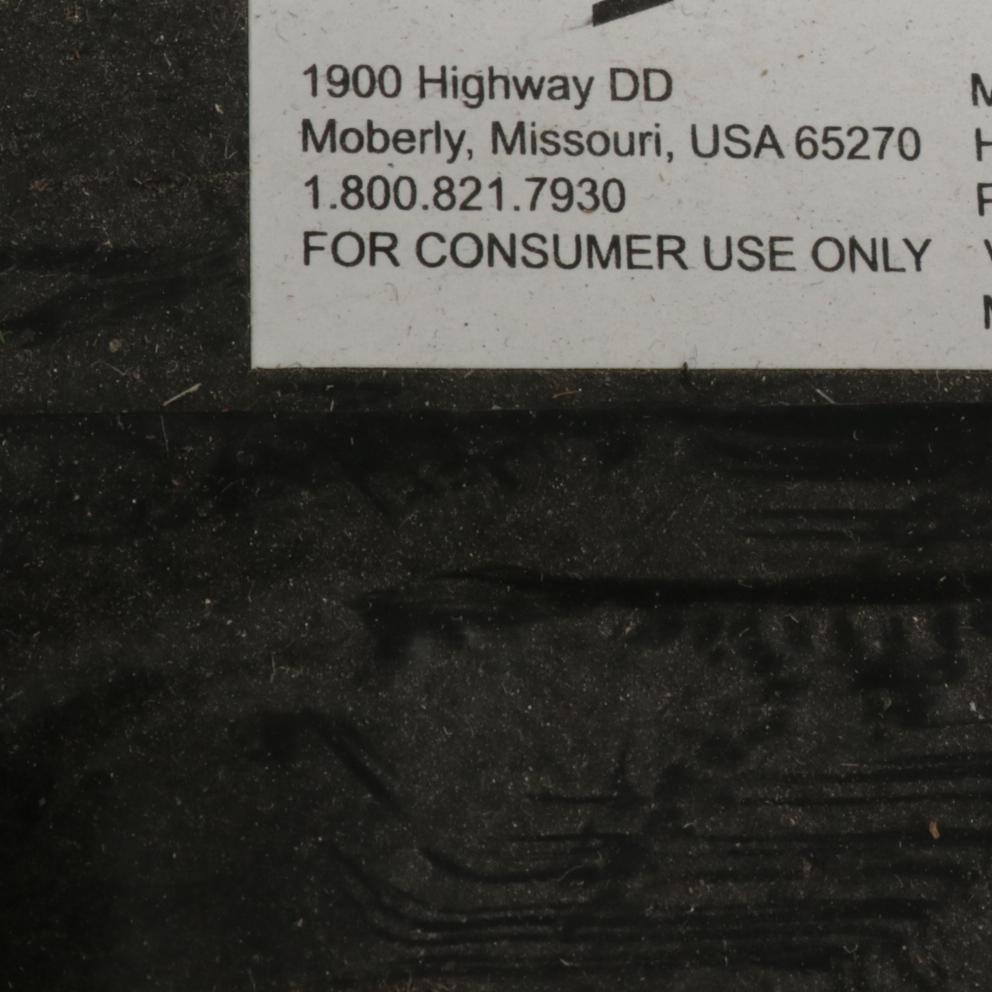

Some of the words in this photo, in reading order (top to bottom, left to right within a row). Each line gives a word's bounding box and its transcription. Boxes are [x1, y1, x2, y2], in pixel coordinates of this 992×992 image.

[303, 63, 402, 99] 1900
[418, 64, 595, 111] Highway
[609, 67, 673, 103] DD
[301, 118, 473, 165] Moberly,
[491, 120, 674, 164] Missouri,
[690, 123, 785, 160] USA
[794, 125, 921, 162] 65270
[304, 174, 626, 214] 1.800.821.7930
[303, 230, 401, 268] FOR
[415, 231, 689, 271] CONSUMER
[703, 235, 797, 273] USE
[811, 235, 932, 273] ONLY
